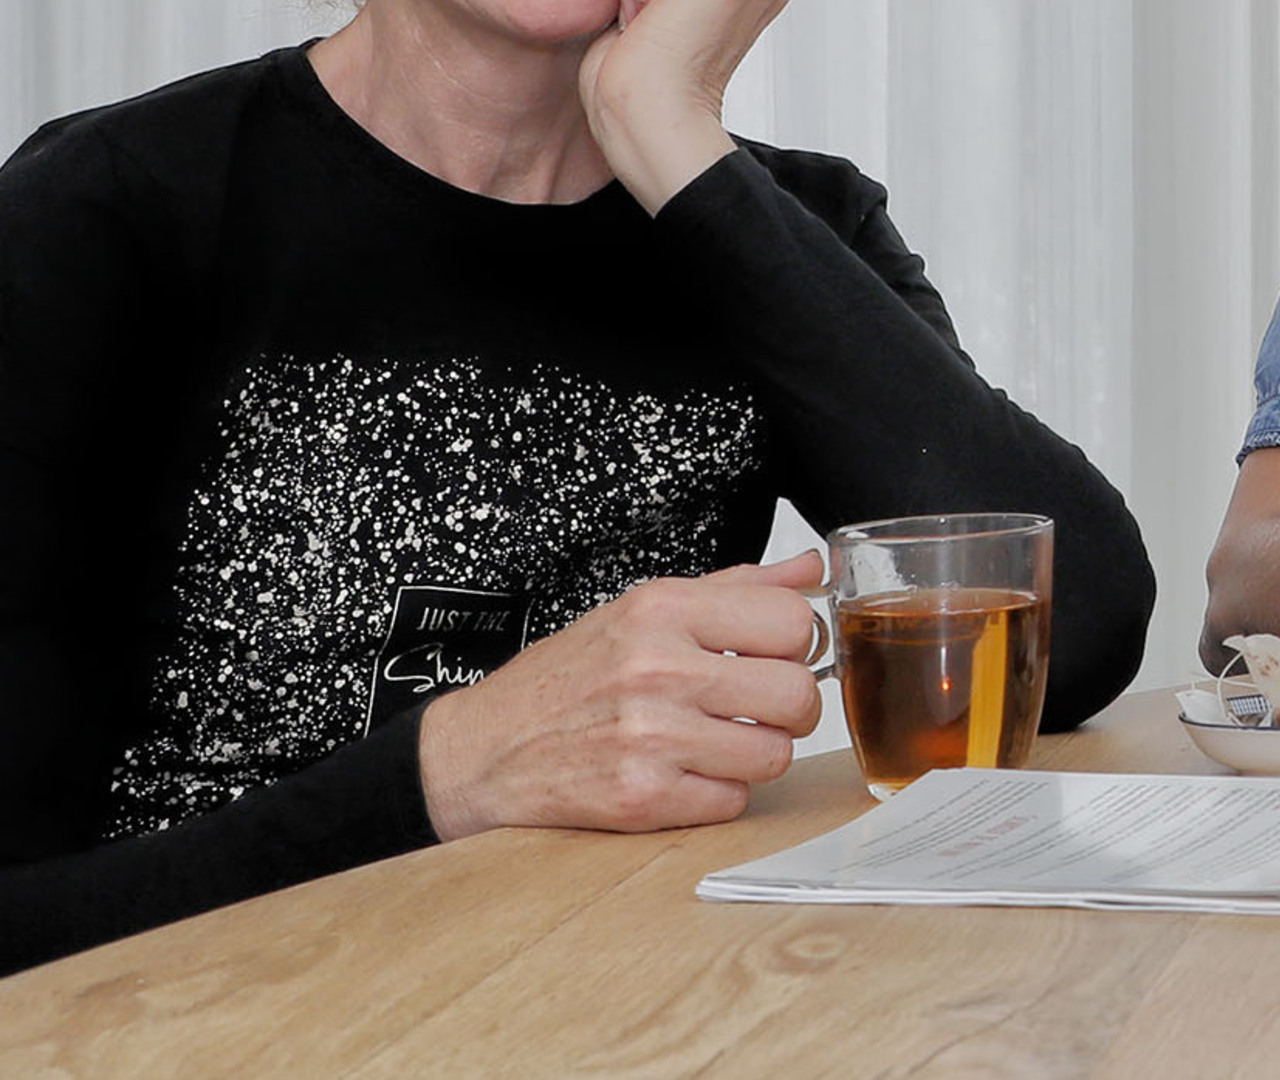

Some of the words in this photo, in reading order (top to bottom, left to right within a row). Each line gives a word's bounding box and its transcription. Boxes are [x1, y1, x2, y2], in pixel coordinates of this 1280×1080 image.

[416, 607, 471, 631] JUST
[473, 610, 511, 631] THE
[384, 643, 486, 693] Shin
